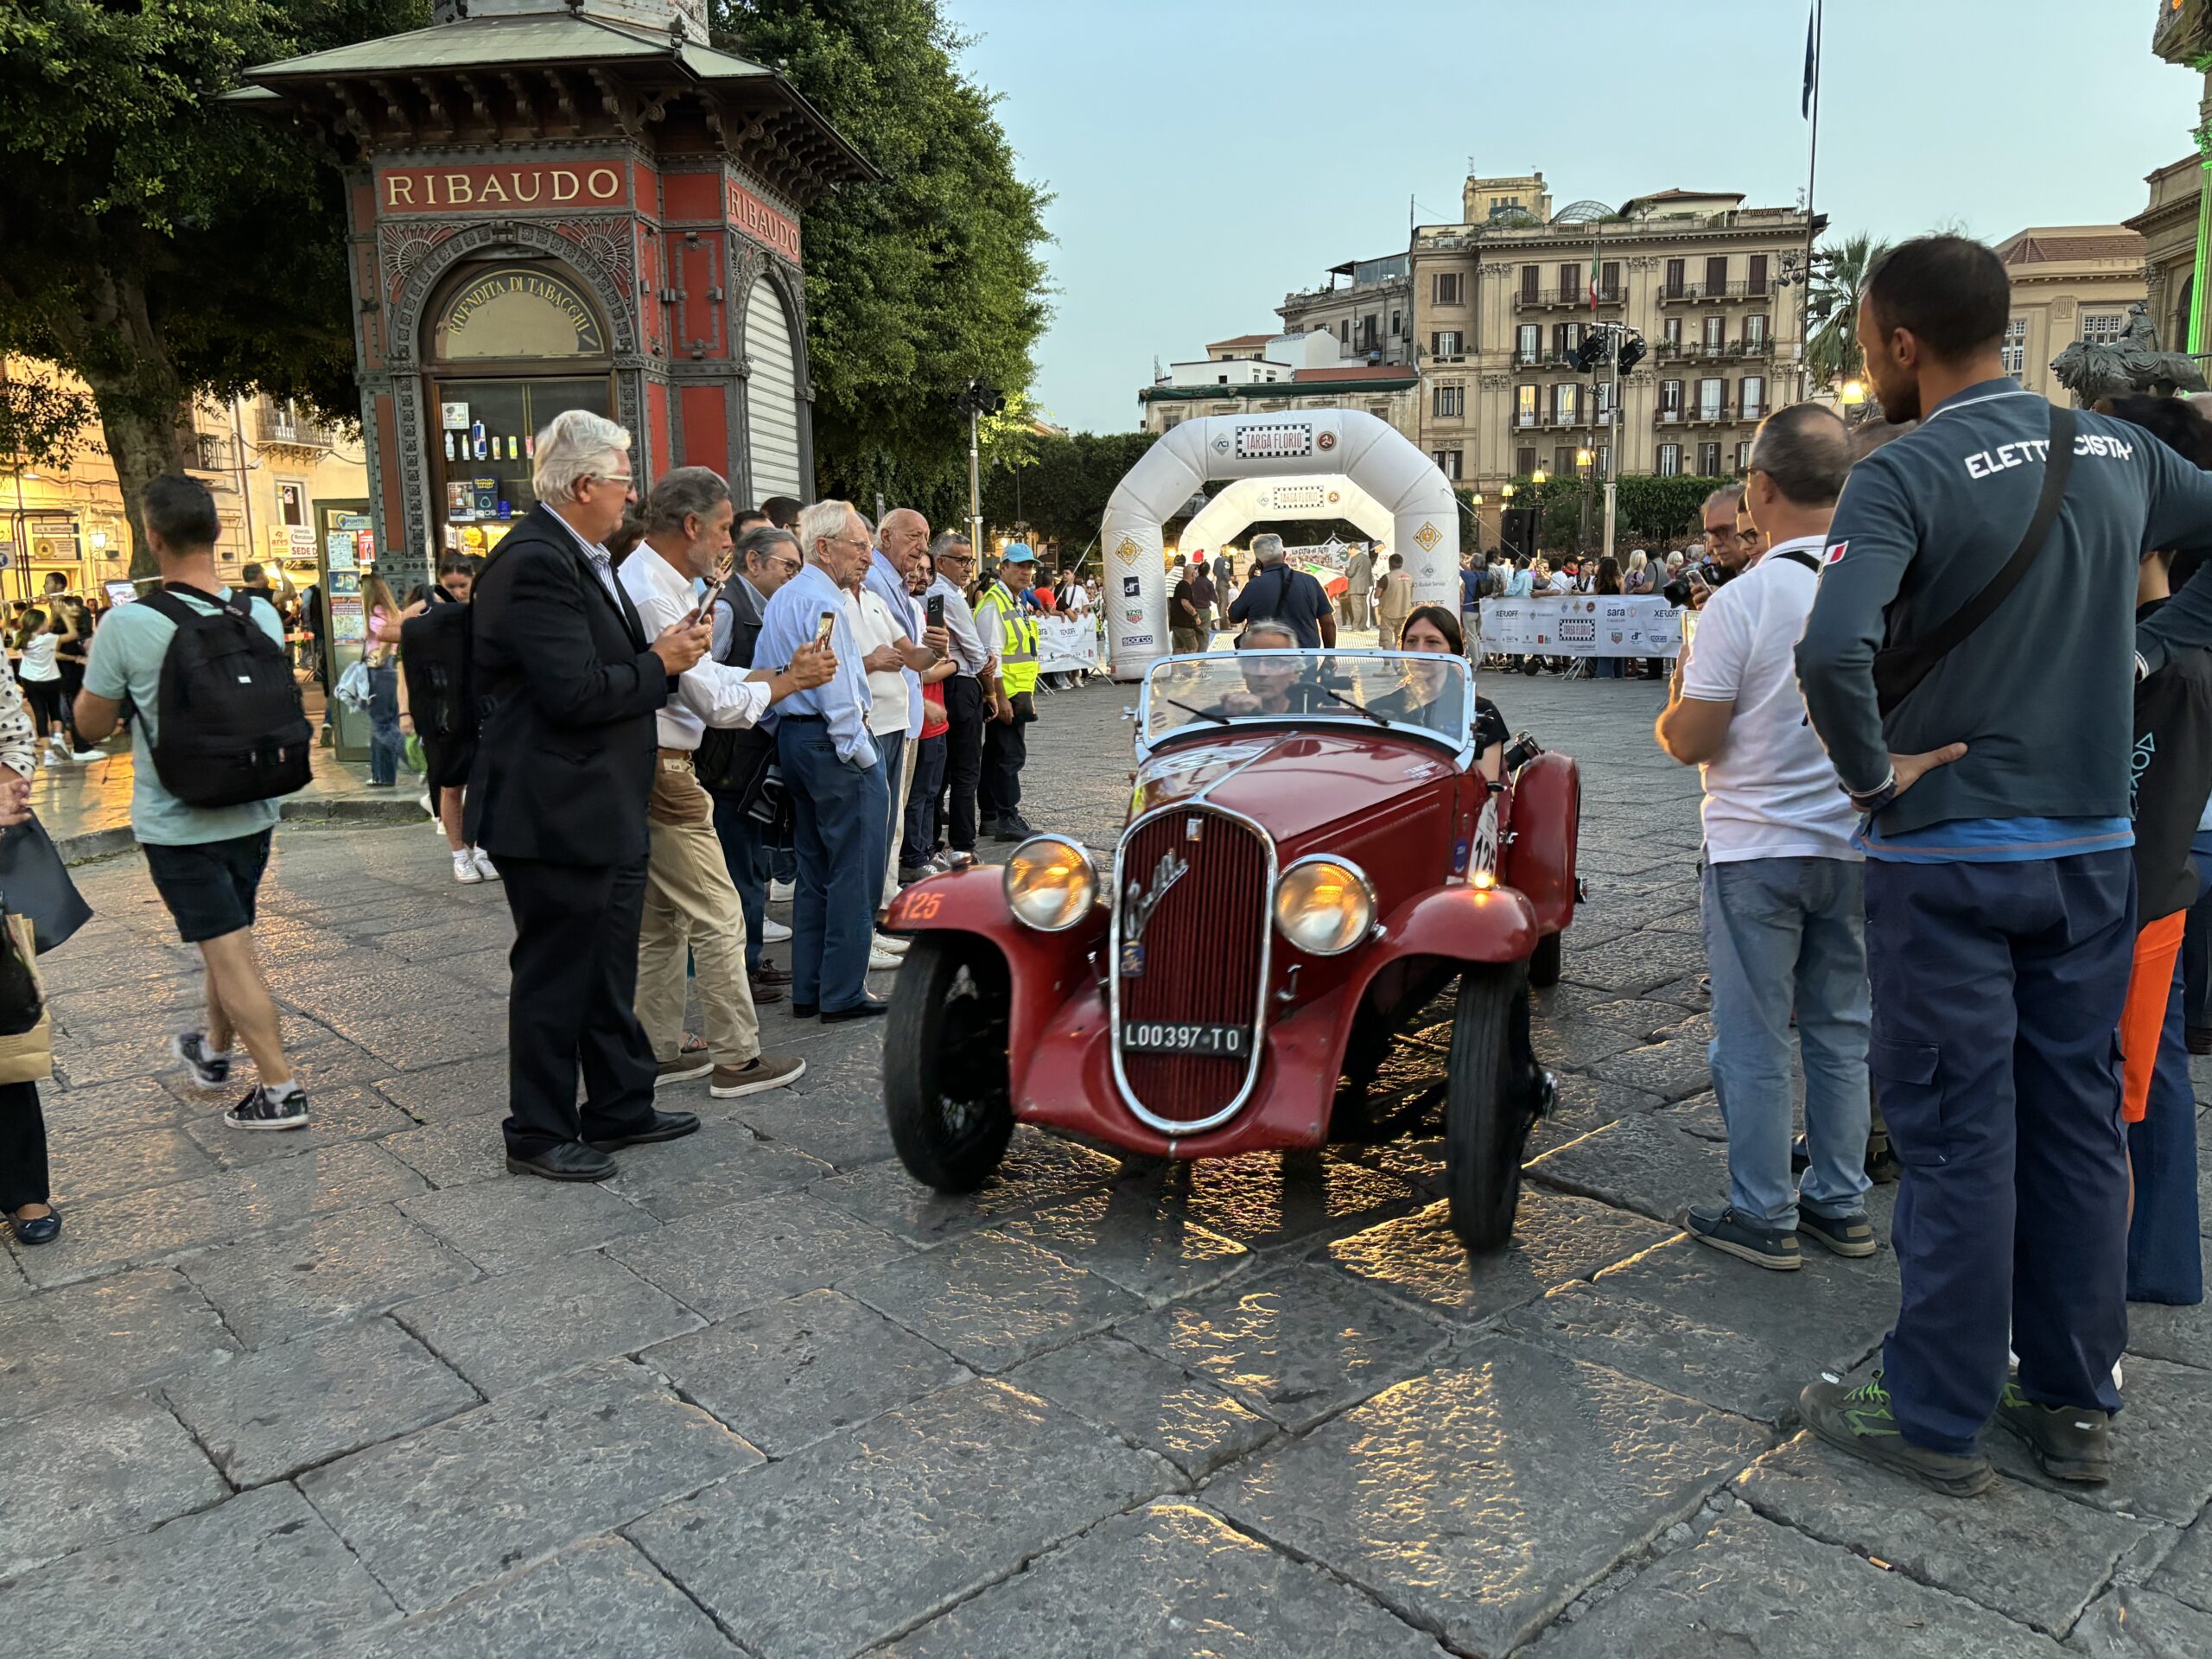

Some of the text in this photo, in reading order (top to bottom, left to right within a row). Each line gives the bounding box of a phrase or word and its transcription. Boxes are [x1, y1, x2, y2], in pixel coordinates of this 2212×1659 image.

[386, 168, 620, 206] RIBAUDO
[729, 186, 799, 255] RIBAUDO
[448, 276, 590, 335] RIVENDITA DI TABACCHI
[1245, 432, 1303, 450] TARGA FLORIO
[1964, 434, 2133, 480] ELETTCISTA
[1280, 491, 1318, 503] TARGA FLORIO
[291, 547, 311, 556] SEDE
[1125, 582, 1139, 593] dr
[1495, 609, 1519, 618] XERJOFF
[1606, 608, 1625, 617] sara
[1654, 609, 1680, 618] XERJOFF
[1038, 627, 1048, 636] ara
[1563, 625, 1591, 636] TARGA FLORIO
[1630, 632, 1643, 640] dr
[1122, 636, 1153, 645] sparco
[901, 892, 946, 920] 125
